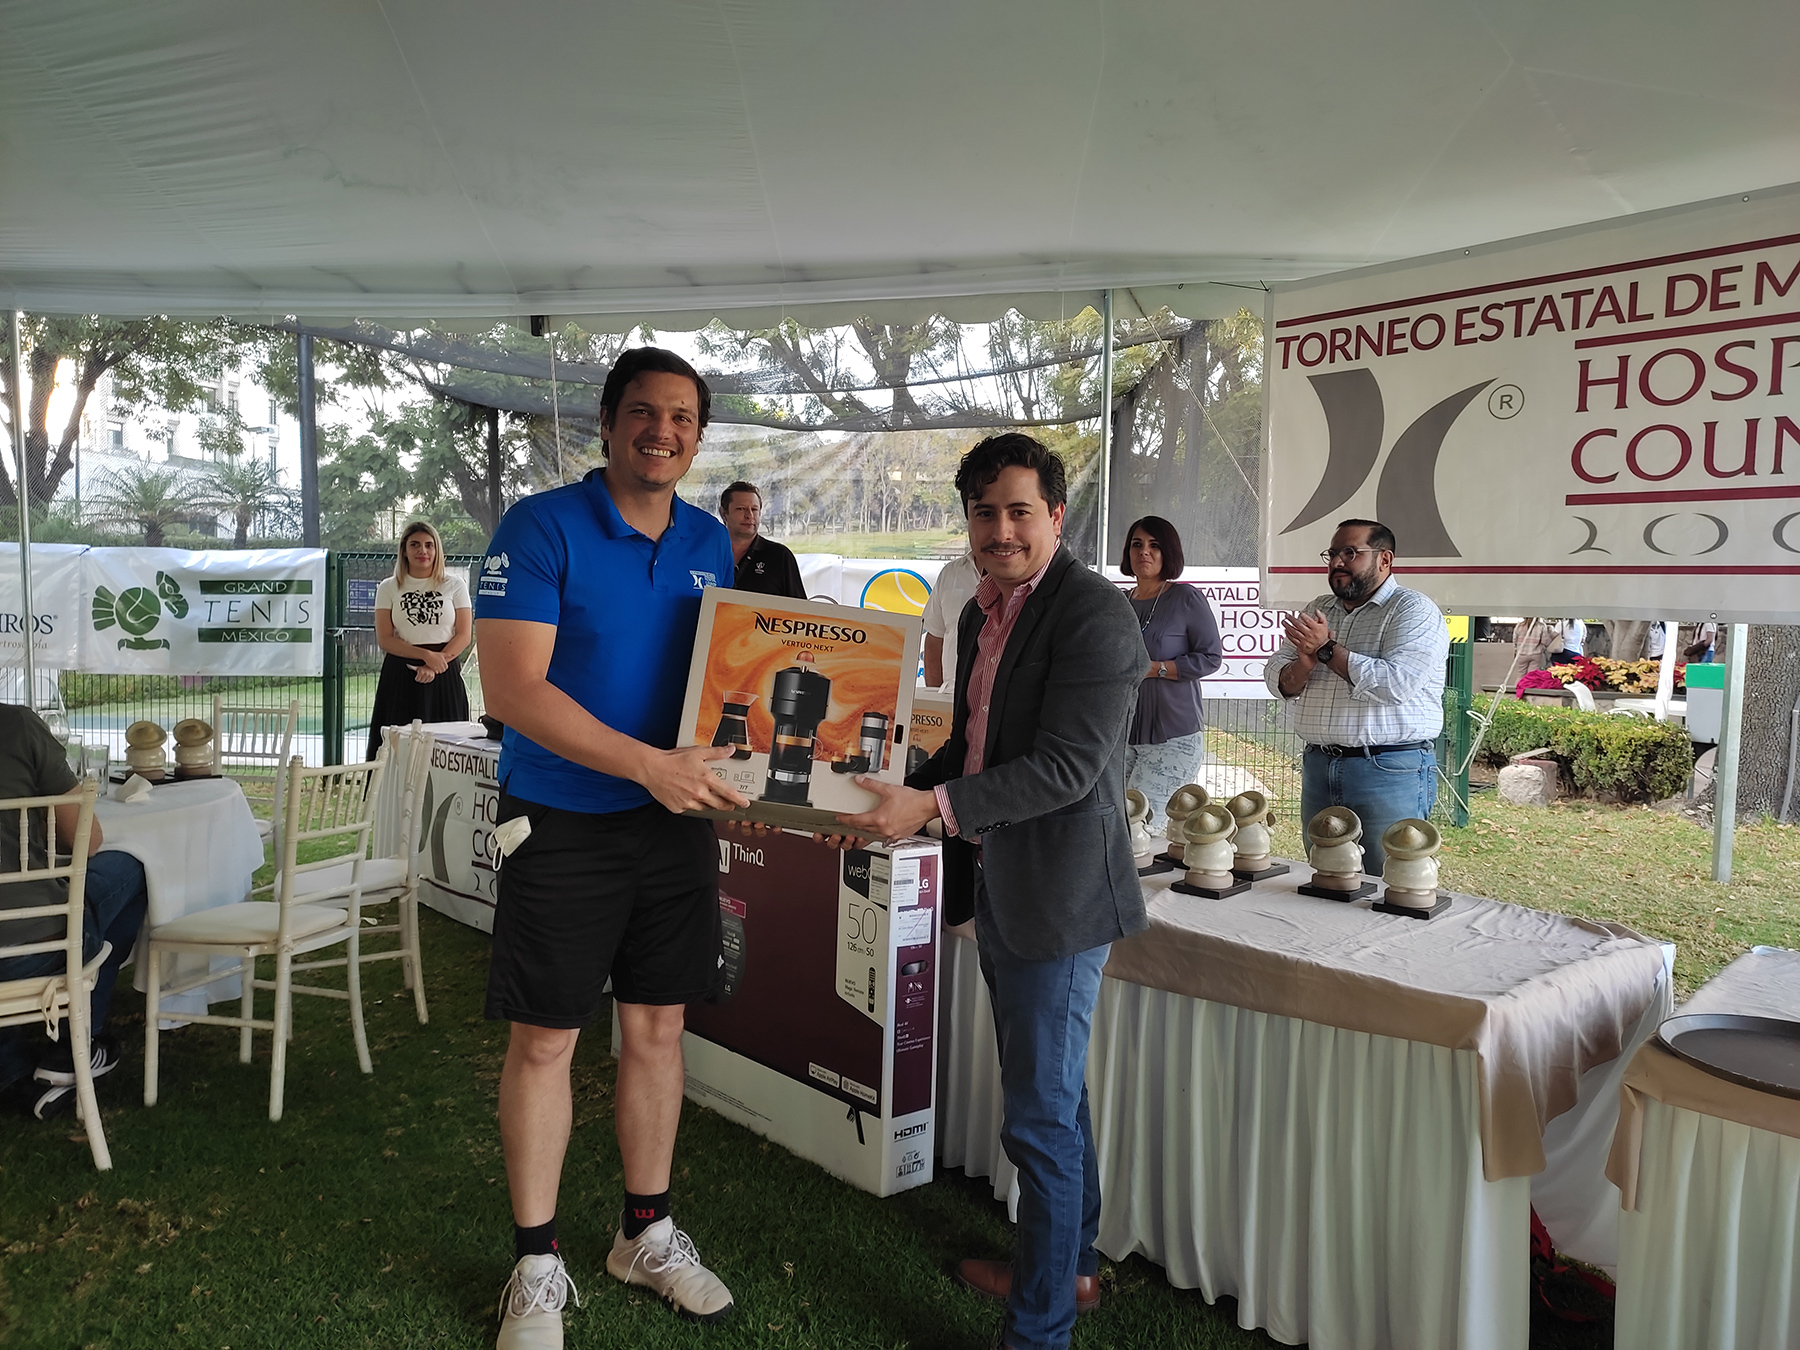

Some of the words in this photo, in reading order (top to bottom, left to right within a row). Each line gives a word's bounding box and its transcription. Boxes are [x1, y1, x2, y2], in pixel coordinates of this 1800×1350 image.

[1276, 313, 1446, 370] TORNEO
[1454, 281, 1655, 347] ESTATAL
[1664, 264, 1744, 318] DE
[223, 581, 288, 593] GRAND
[204, 600, 311, 625] TENIS
[221, 628, 290, 643] MÉXICO
[753, 611, 867, 644] NESPRESSO
[781, 639, 812, 650] VERTUO
[813, 644, 834, 653] NEXT
[911, 713, 943, 728] PRESSO
[447, 751, 491, 780] ESTATAL
[733, 843, 765, 867] ThinQ
[847, 902, 877, 944] 50
[894, 1122, 927, 1140] HDMI
